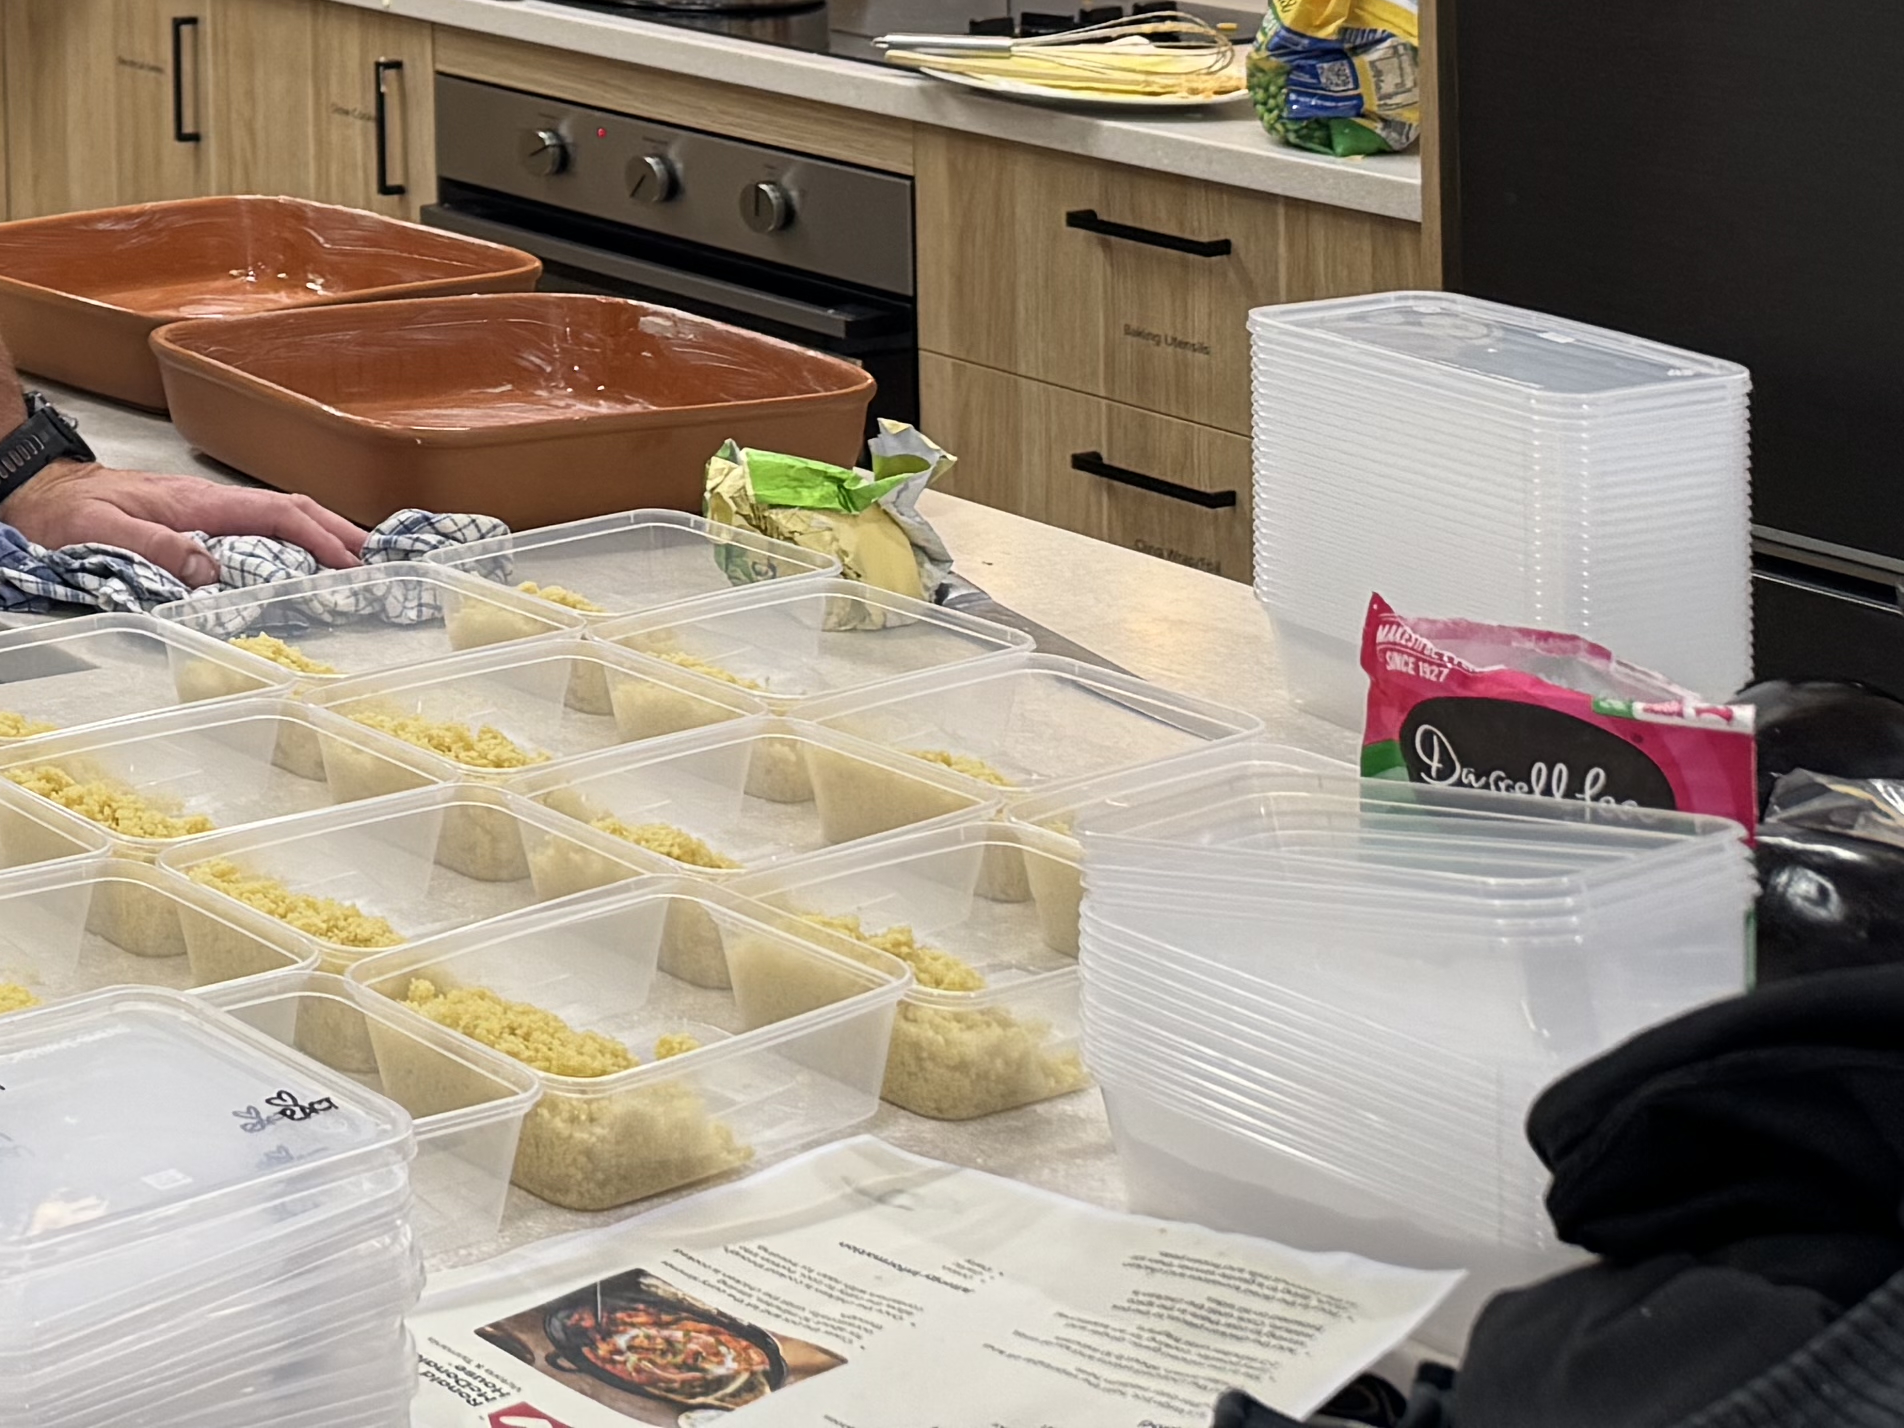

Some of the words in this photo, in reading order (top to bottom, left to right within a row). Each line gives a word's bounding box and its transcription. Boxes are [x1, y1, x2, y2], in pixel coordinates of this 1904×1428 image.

[1123, 323, 1161, 346] Baking
[1164, 334, 1211, 356] Utensils
[1386, 650, 1416, 675] SINCE
[1418, 660, 1450, 682] 1927
[418, 1370, 484, 1407] Ronald
[454, 1364, 511, 1398] House
